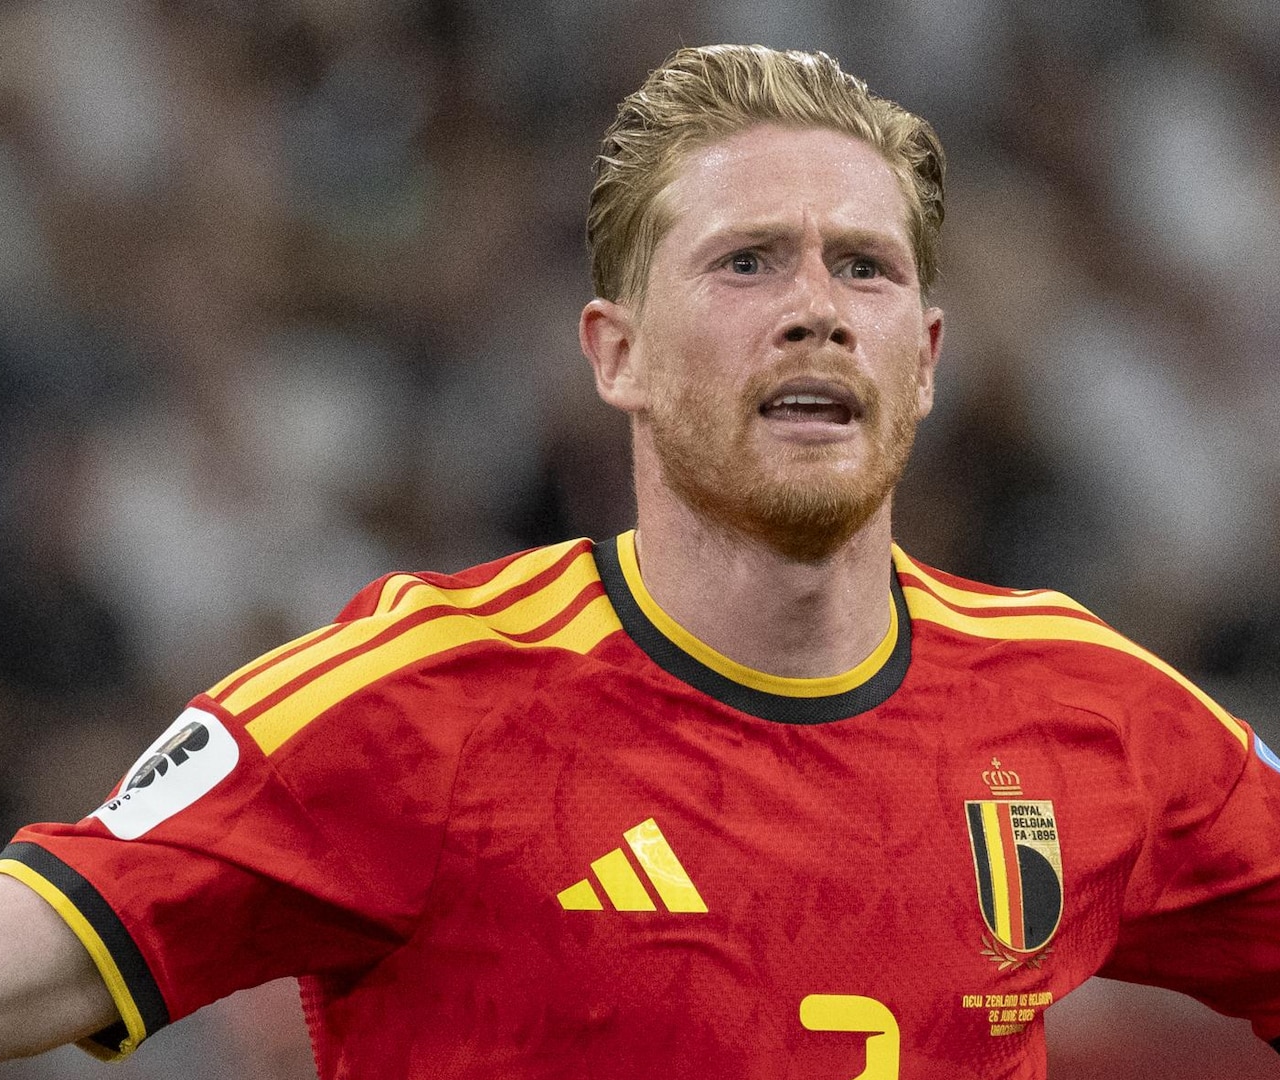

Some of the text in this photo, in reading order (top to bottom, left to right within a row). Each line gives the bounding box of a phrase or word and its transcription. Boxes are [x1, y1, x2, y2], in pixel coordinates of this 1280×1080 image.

[1011, 805, 1041, 816] ROYAL
[1012, 818, 1054, 828] BELGIAN
[962, 995, 983, 1008] NEW
[985, 995, 1019, 1008] ZEALAND
[989, 1010, 1000, 1023] 26
[1001, 1010, 1018, 1022] JUNE
